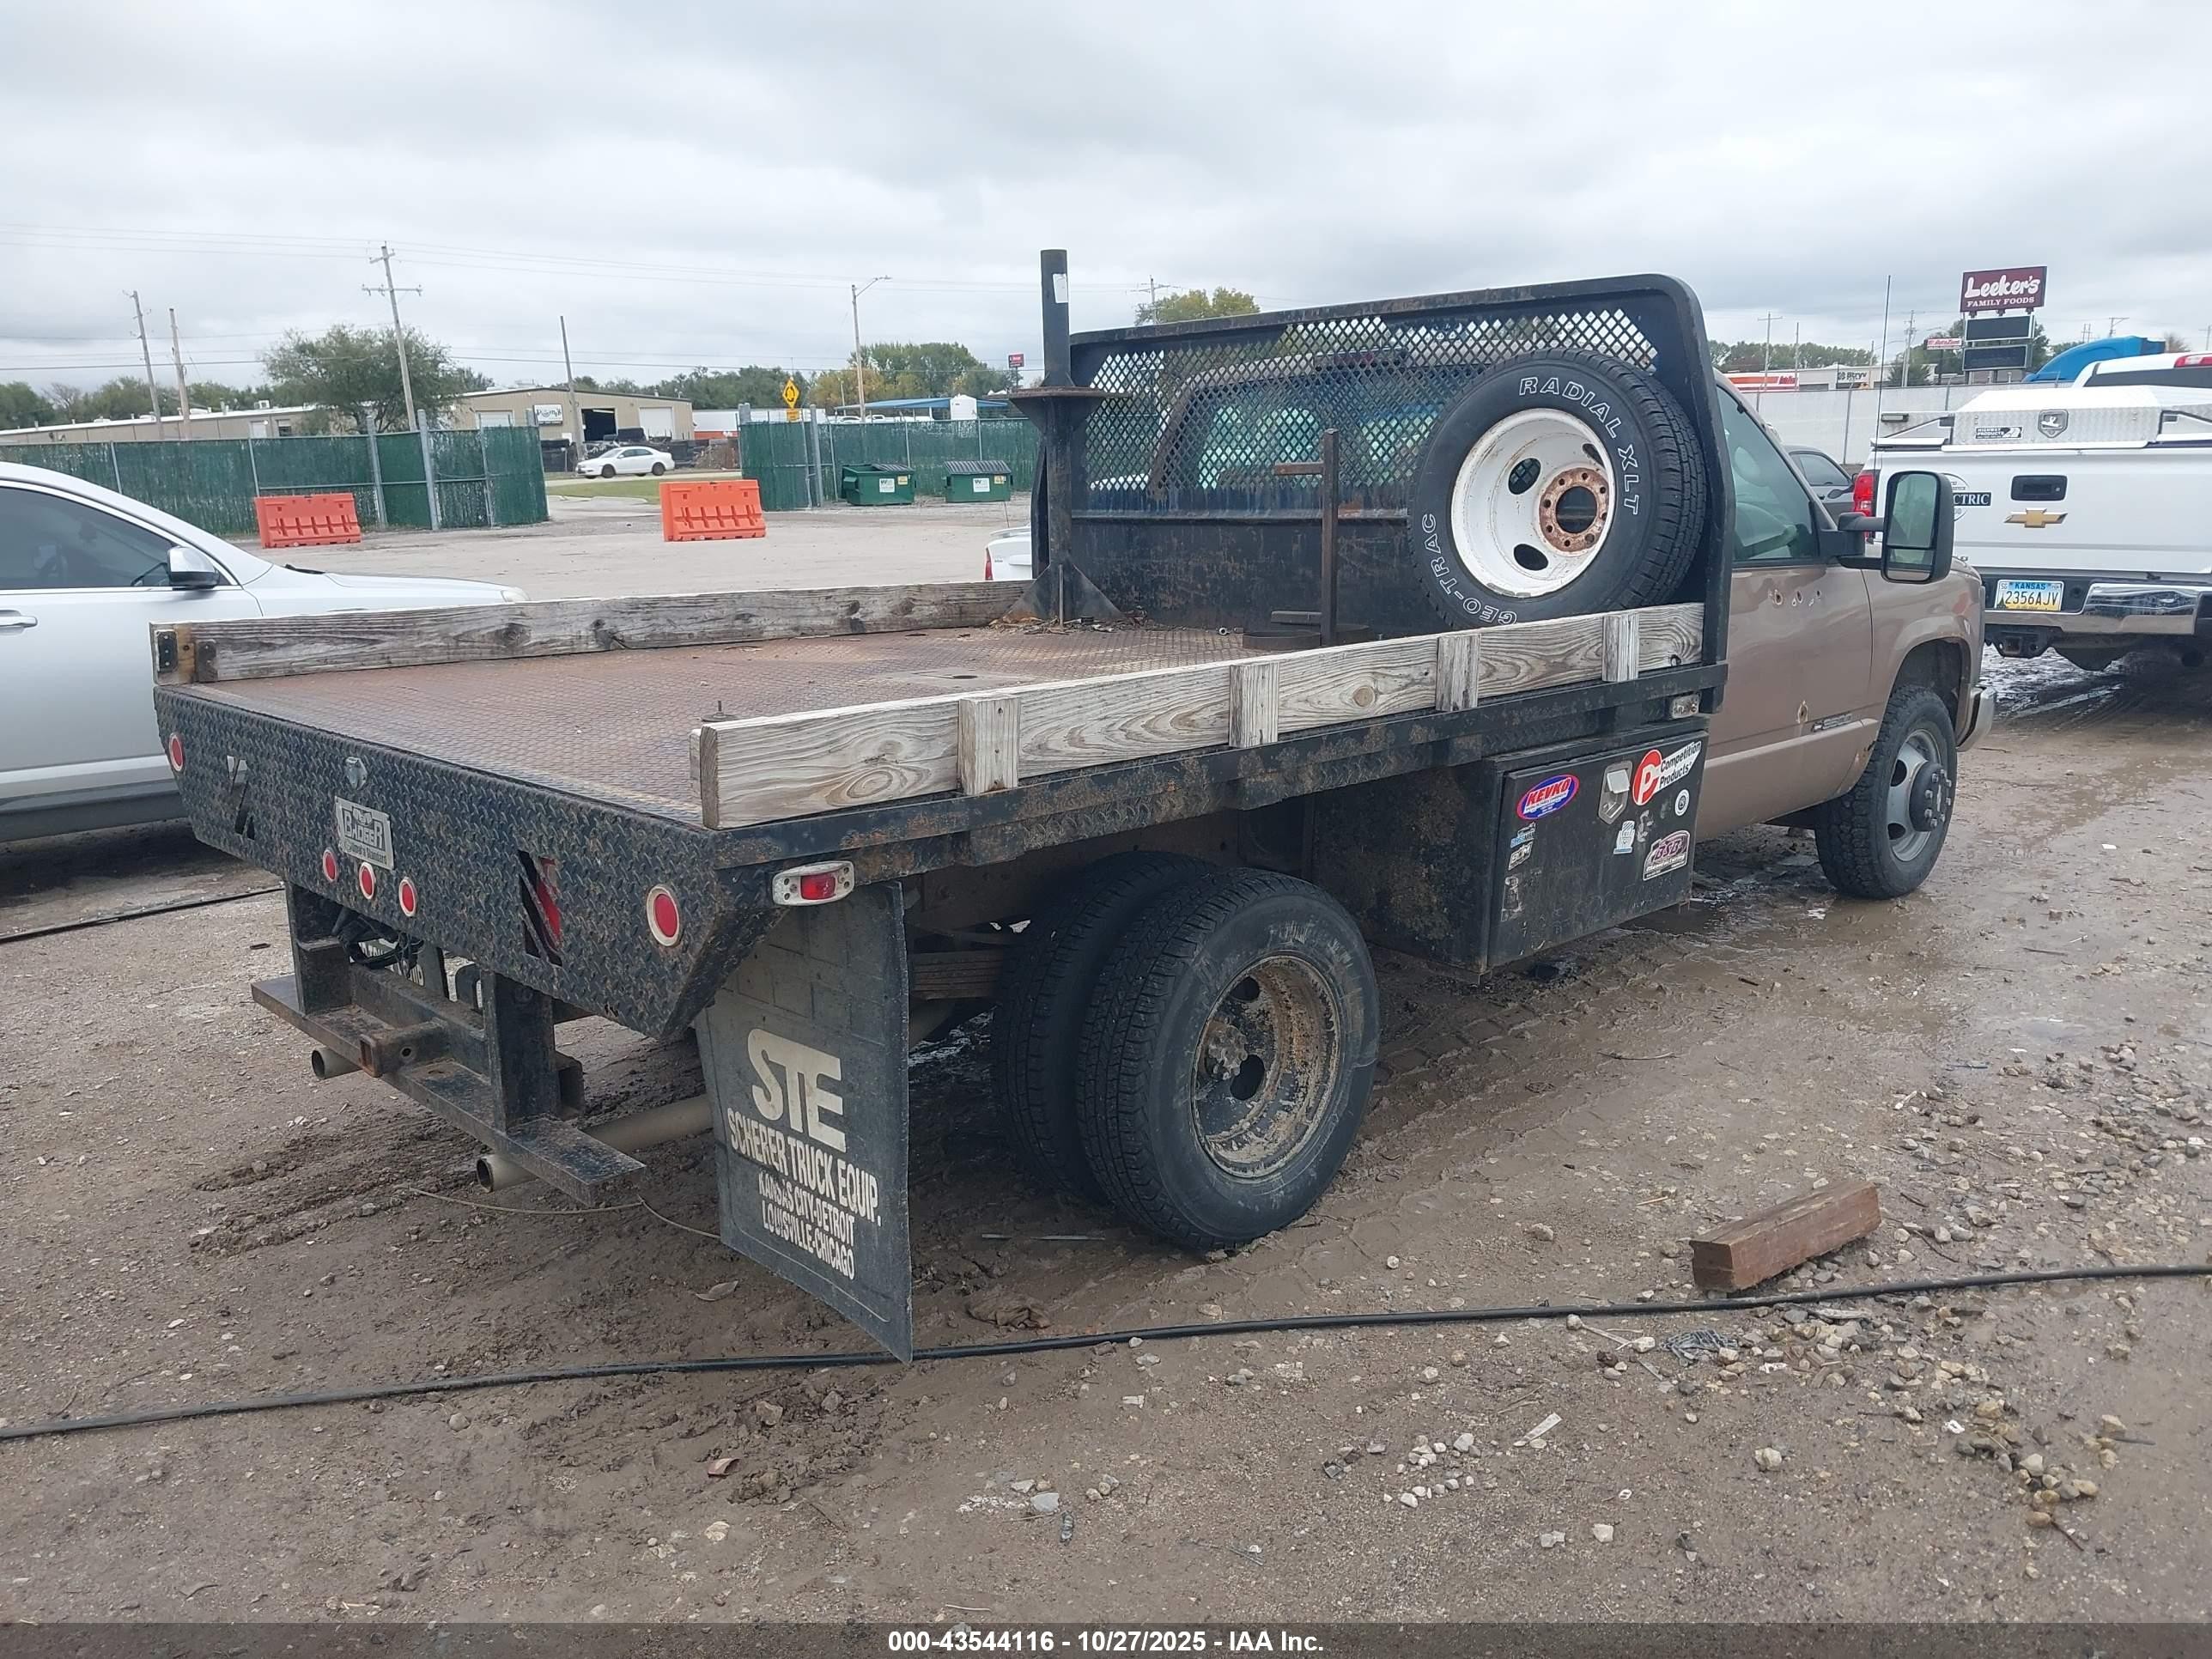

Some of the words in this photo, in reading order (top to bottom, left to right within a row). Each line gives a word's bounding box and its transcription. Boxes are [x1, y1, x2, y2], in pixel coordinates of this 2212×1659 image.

[1965, 275, 2041, 298] Leeker's
[1967, 299, 2002, 307] FAMILY
[2003, 296, 2035, 305] FOODS
[1519, 376, 1622, 439] RADIAL
[1618, 443, 1640, 516] XLT
[1953, 493, 1990, 505] CTRIC
[1421, 514, 1517, 625] GEO-TRAC
[1660, 763, 1689, 788] Products
[1661, 742, 1701, 773] Competition
[1526, 776, 1571, 807] KEVKO
[343, 809, 384, 850] BADGER
[747, 1028, 847, 1153] STE
[727, 1107, 789, 1176] SCHERER
[787, 1136, 836, 1201] TRUCK
[836, 1158, 882, 1227] EQUIP.
[758, 1170, 794, 1213] KANSAS
